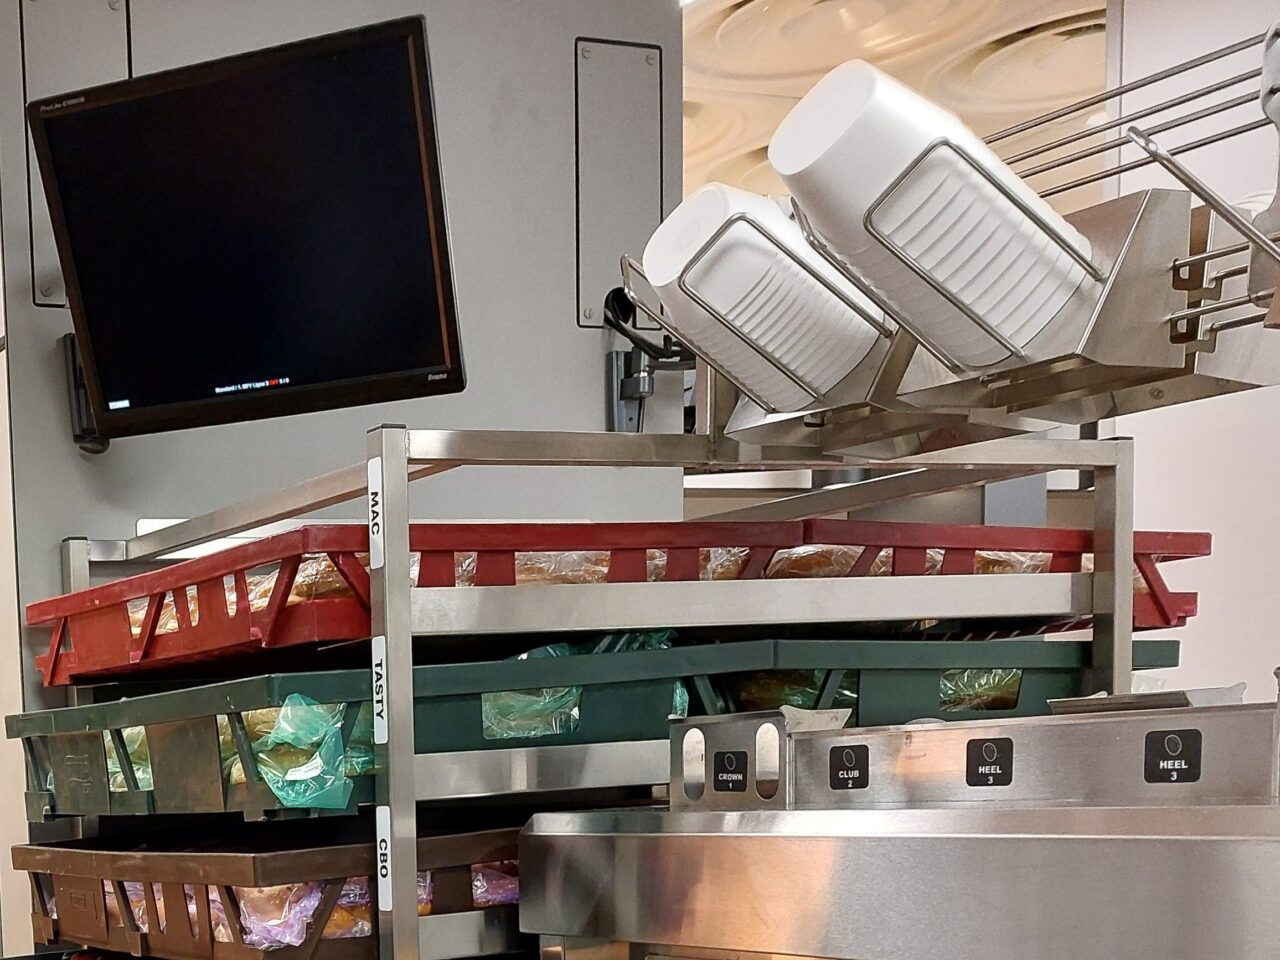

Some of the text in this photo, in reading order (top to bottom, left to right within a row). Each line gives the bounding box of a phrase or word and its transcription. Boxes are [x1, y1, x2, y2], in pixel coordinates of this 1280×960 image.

[370, 491, 380, 536] MAC
[374, 658, 384, 721] TASTY
[1159, 759, 1189, 769] HEEL
[838, 770, 860, 778] CLUB
[978, 765, 1003, 774] HEEL
[718, 773, 743, 781] CROWN
[987, 776, 994, 784] 3
[1170, 771, 1178, 781] 3
[847, 780, 853, 788] 2
[379, 838, 389, 879] CBO
